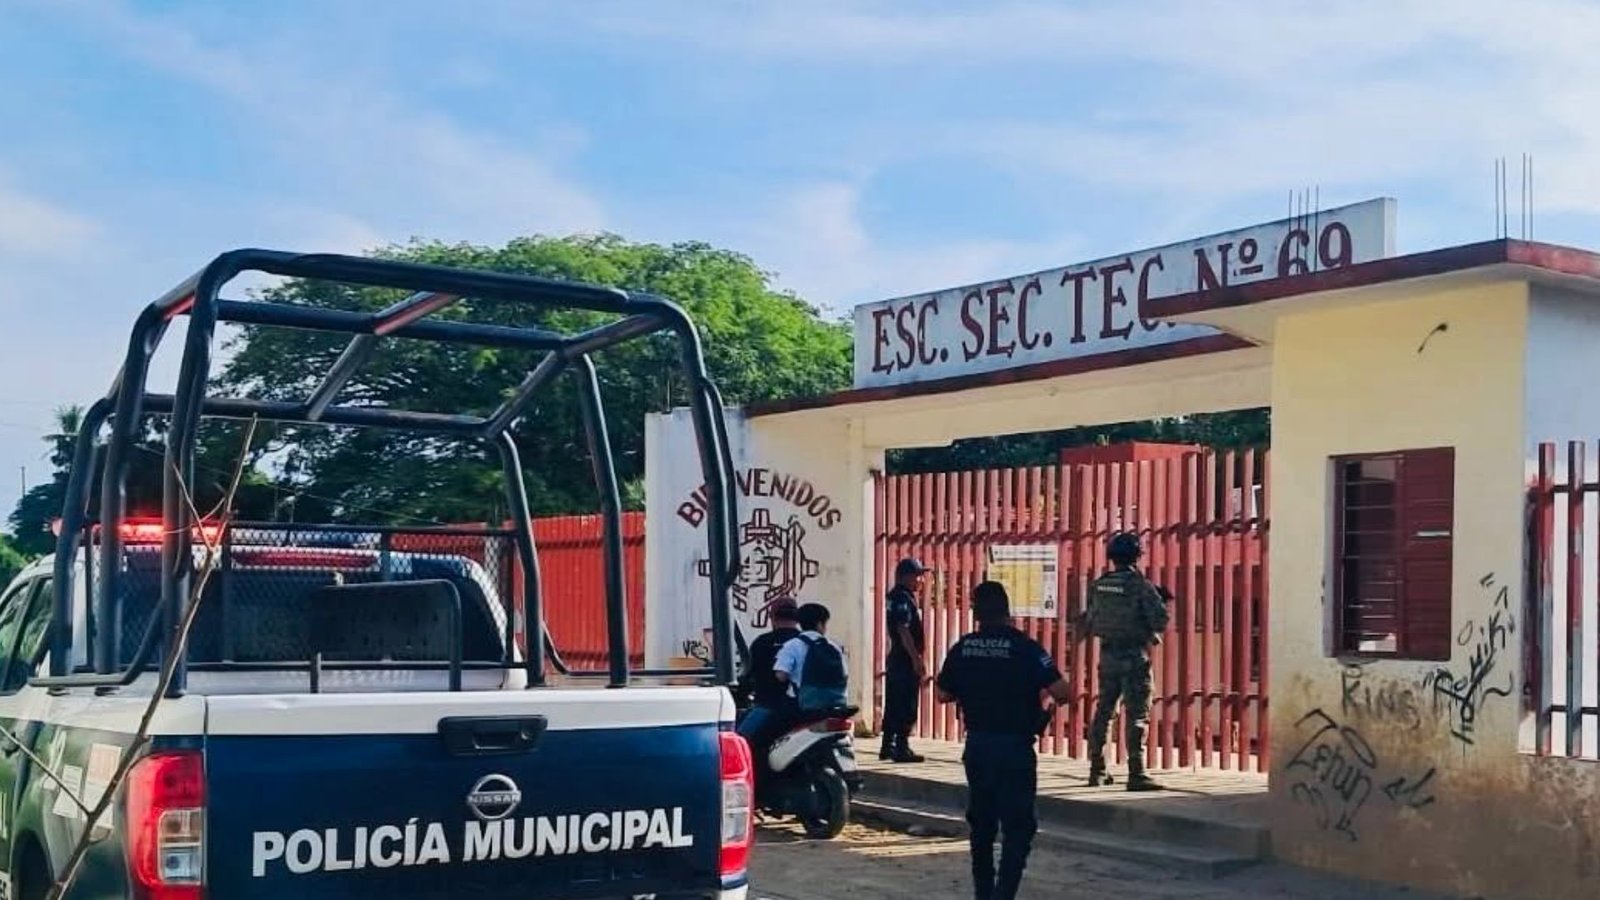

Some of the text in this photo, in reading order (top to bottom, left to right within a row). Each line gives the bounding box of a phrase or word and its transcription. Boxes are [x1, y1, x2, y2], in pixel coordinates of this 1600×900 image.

[872, 297, 949, 375] ESC.
[961, 280, 1052, 362] SEC.
[1278, 222, 1353, 277] 69
[677, 468, 841, 531] BIVENIDOS
[252, 806, 694, 877] POLICÍA MUNICIPAL
